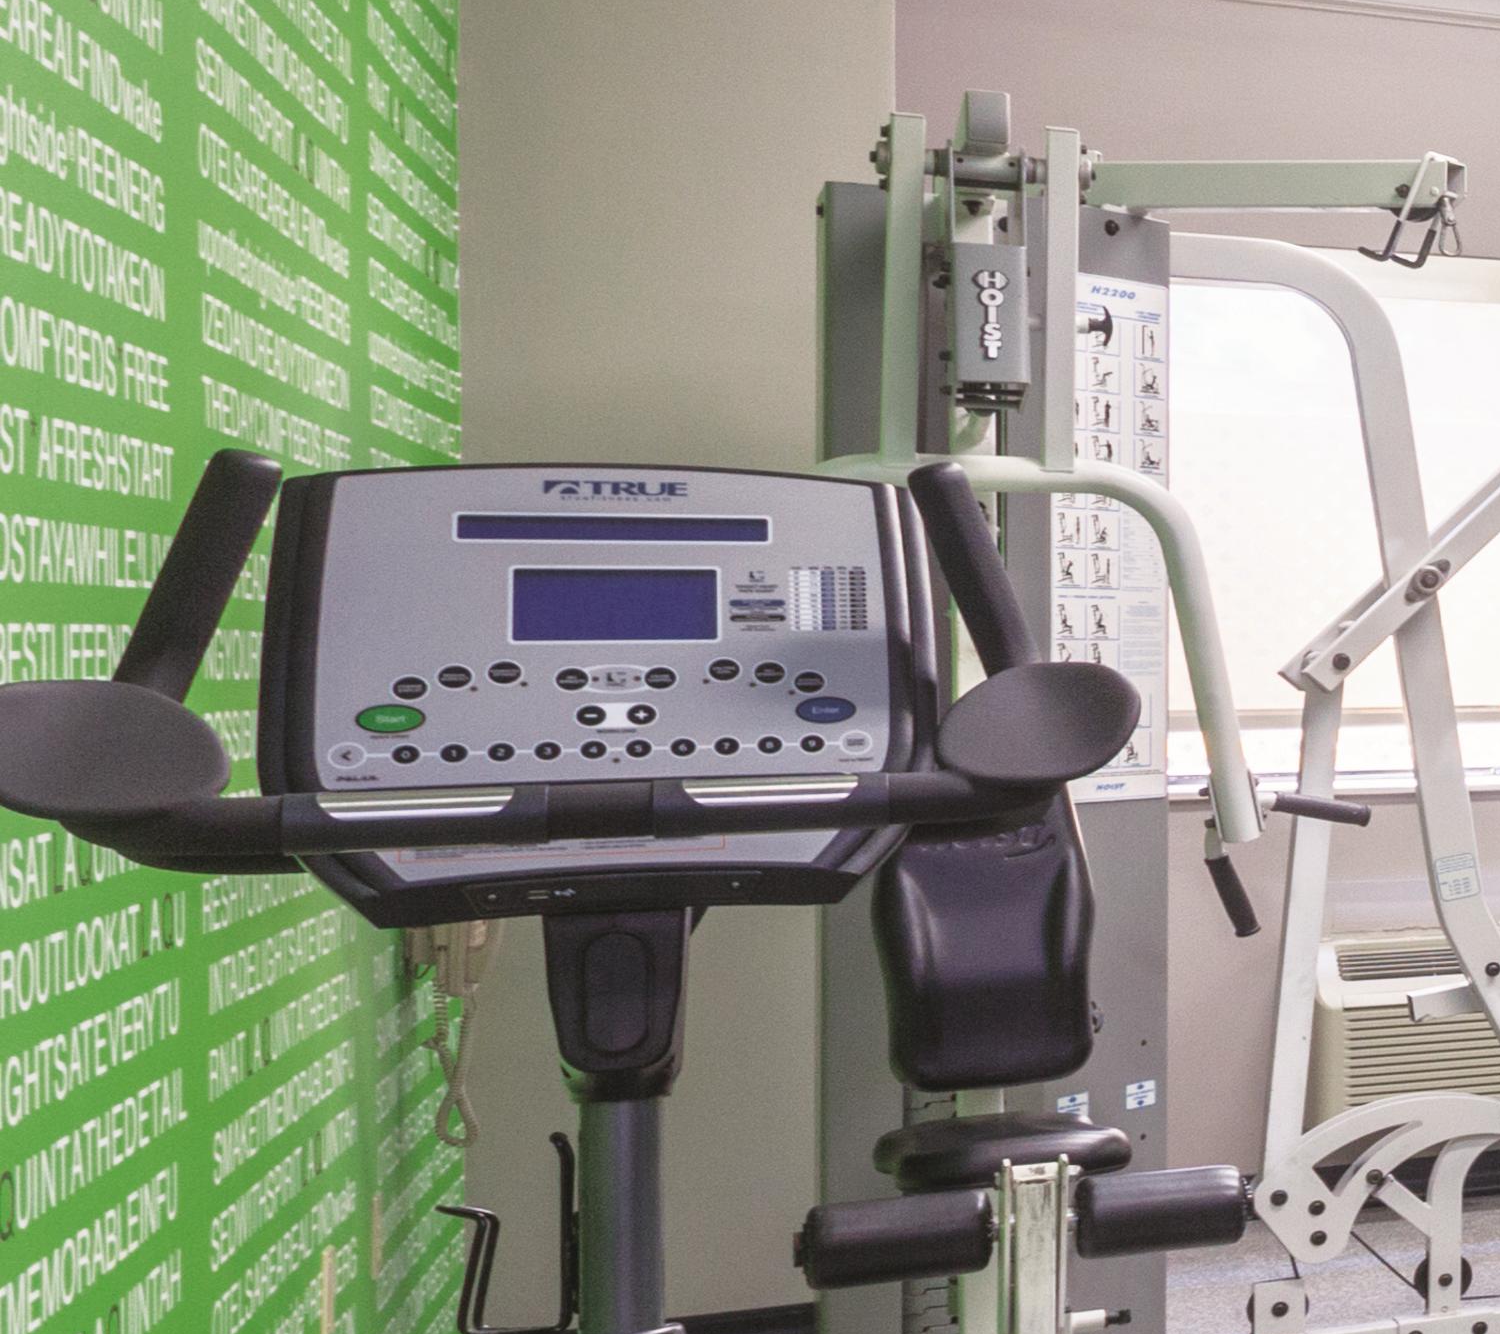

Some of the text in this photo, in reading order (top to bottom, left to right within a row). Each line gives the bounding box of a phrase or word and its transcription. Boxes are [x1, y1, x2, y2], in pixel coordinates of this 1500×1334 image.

[1090, 284, 1137, 300] H2200
[972, 269, 1009, 360] HOIST
[583, 480, 688, 496] TRUE
